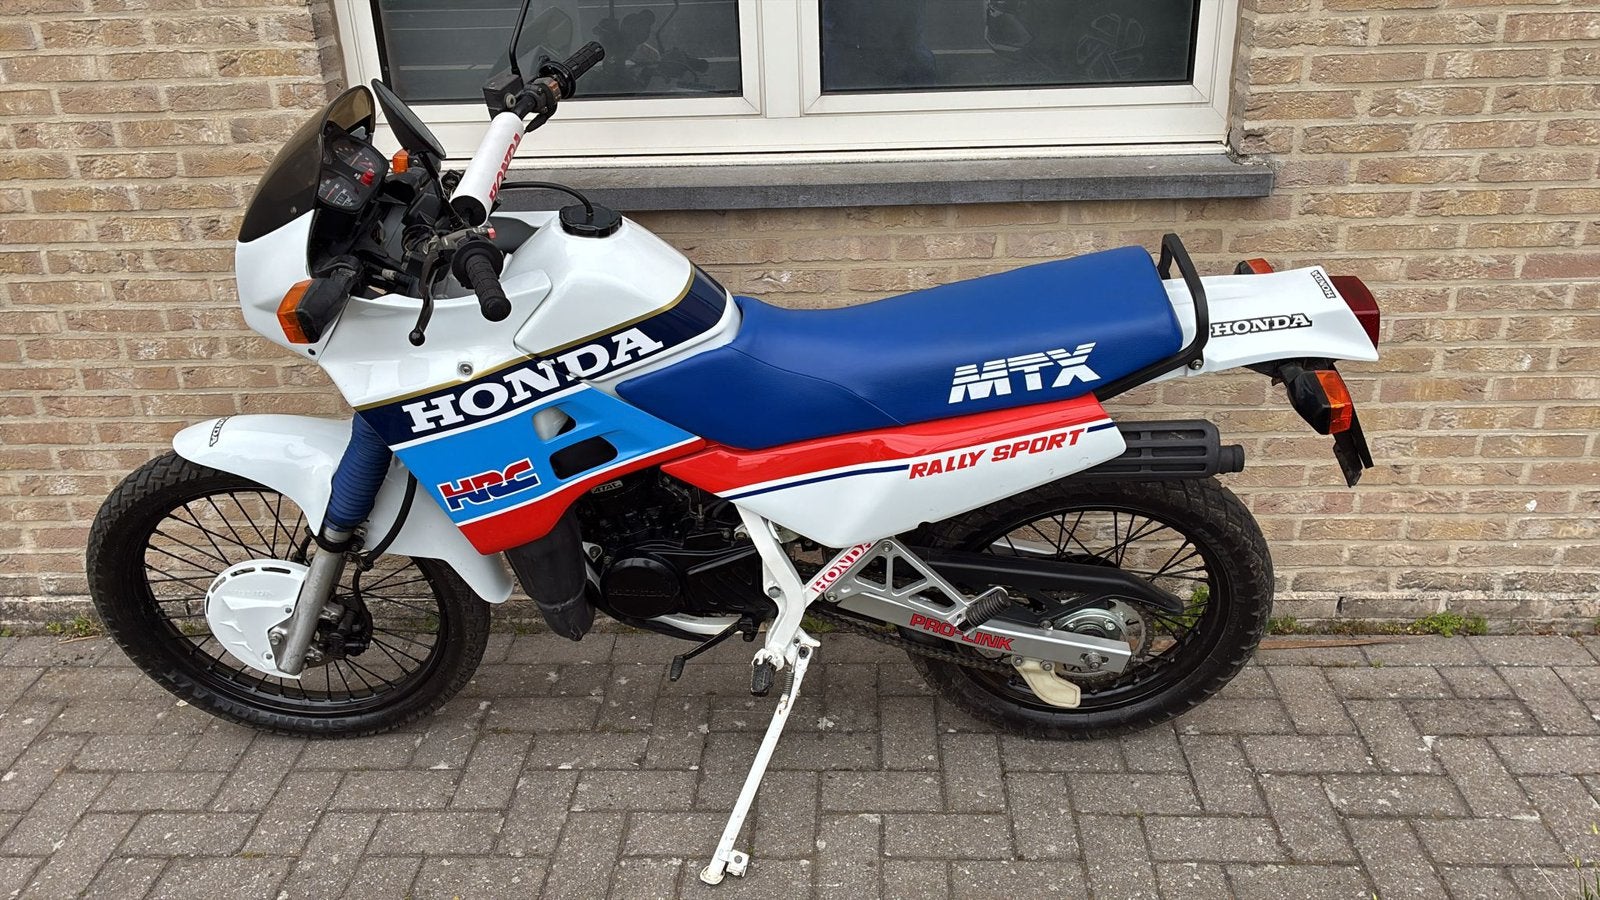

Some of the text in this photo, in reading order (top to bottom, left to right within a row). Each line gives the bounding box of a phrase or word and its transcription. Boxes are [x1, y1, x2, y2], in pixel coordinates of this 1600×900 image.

[1211, 313, 1312, 338] HONDA
[402, 327, 664, 433] HONDA
[948, 342, 1101, 404] MTX
[909, 428, 1085, 480] RALLY SPORT
[437, 457, 542, 512] HRC
